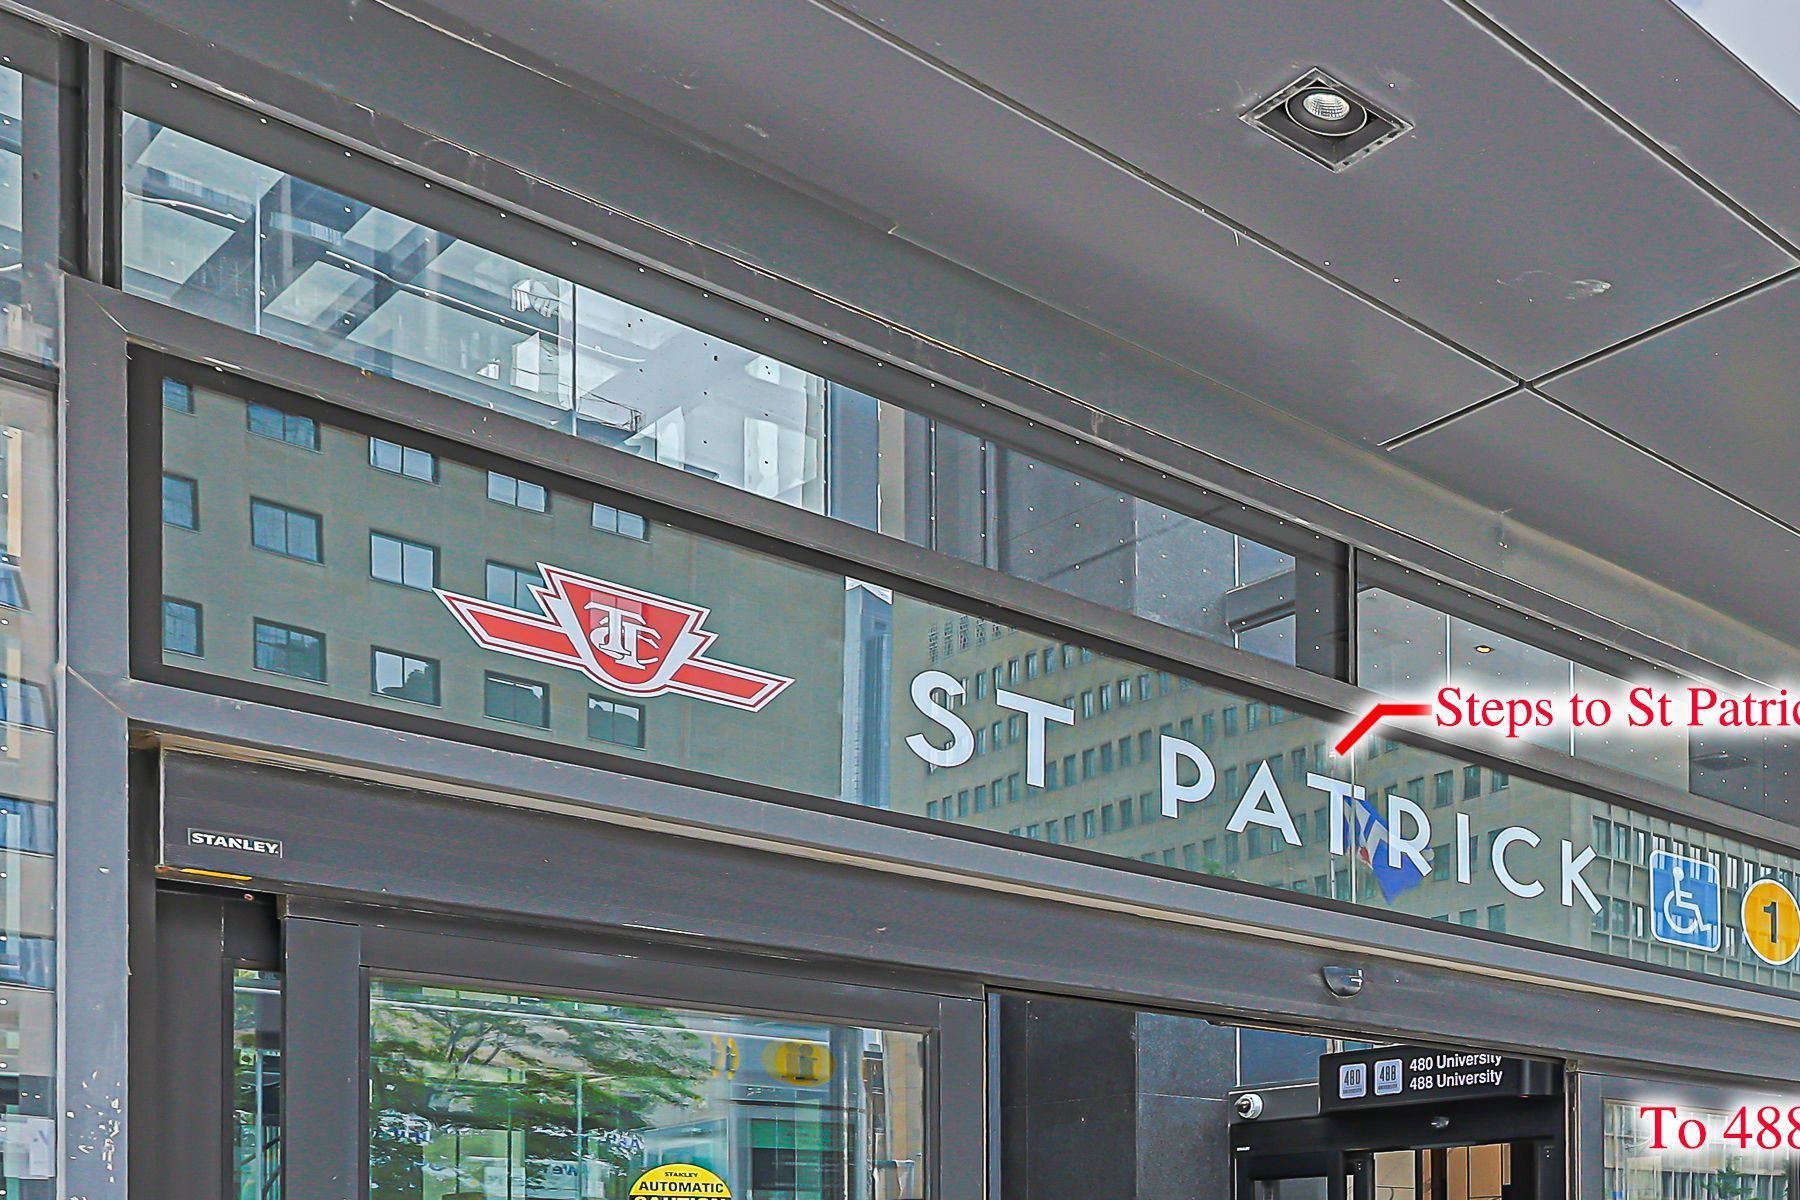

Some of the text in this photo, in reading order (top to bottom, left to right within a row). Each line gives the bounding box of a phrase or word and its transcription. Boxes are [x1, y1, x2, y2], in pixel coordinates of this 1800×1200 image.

[905, 669, 1604, 915] ST PATRICK
[191, 832, 279, 855] STANLEY
[1763, 901, 1777, 943] 1
[1409, 1053, 1502, 1072] 480 University
[1344, 1069, 1361, 1086] 480
[1379, 1065, 1397, 1082] 488
[1409, 1076, 1433, 1091] 488
[1436, 1070, 1503, 1088] University
[638, 1181, 724, 1193] AUTOMATIC
